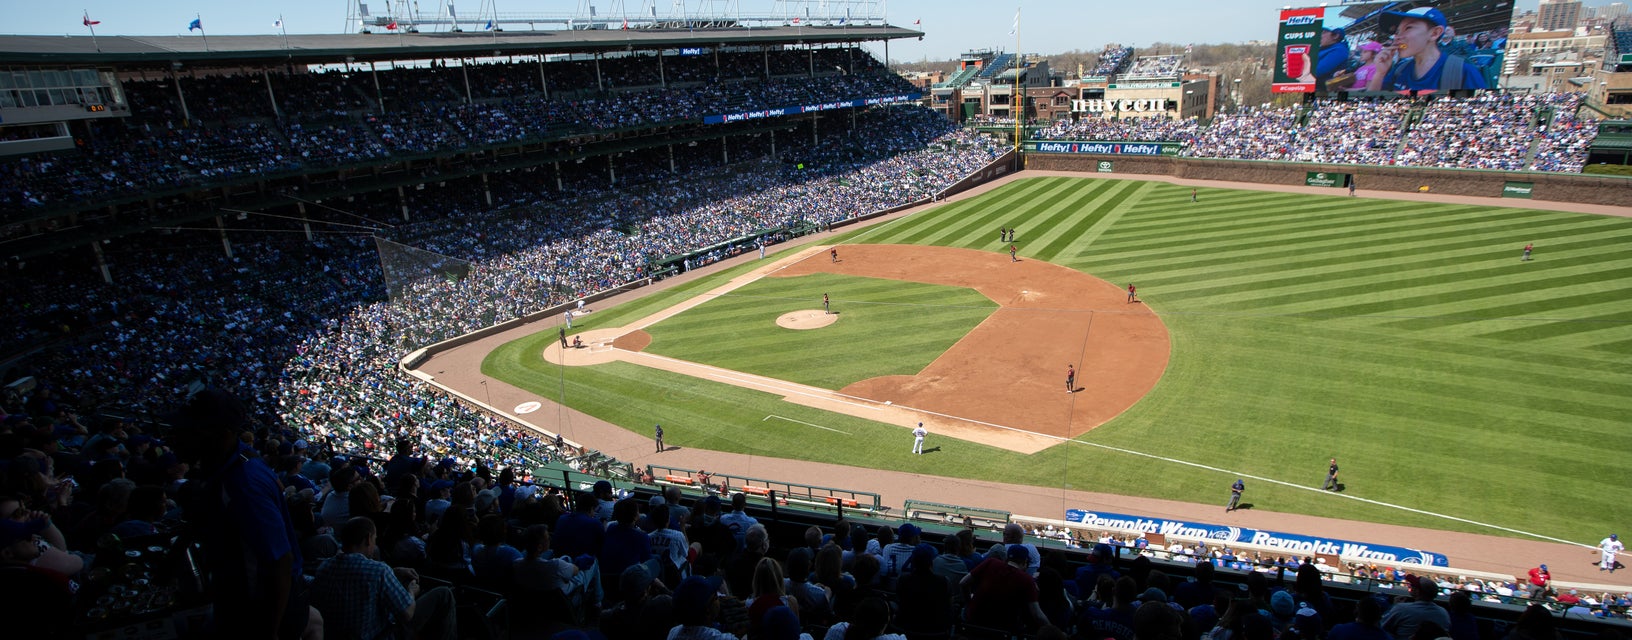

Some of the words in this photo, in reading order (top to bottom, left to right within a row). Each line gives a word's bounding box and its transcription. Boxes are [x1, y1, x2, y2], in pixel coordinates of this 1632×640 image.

[1288, 16, 1315, 25] Hefty
[1304, 31, 1316, 39] UP
[1071, 98, 1167, 113] nuveen
[1040, 142, 1070, 153] Hefty!
[1080, 143, 1113, 154] Hefty!
[1123, 144, 1158, 155] Hefty!
[1080, 511, 1158, 535] Reynolds
[1158, 520, 1209, 541] Wrap
[1251, 531, 1341, 556] Reynolds
